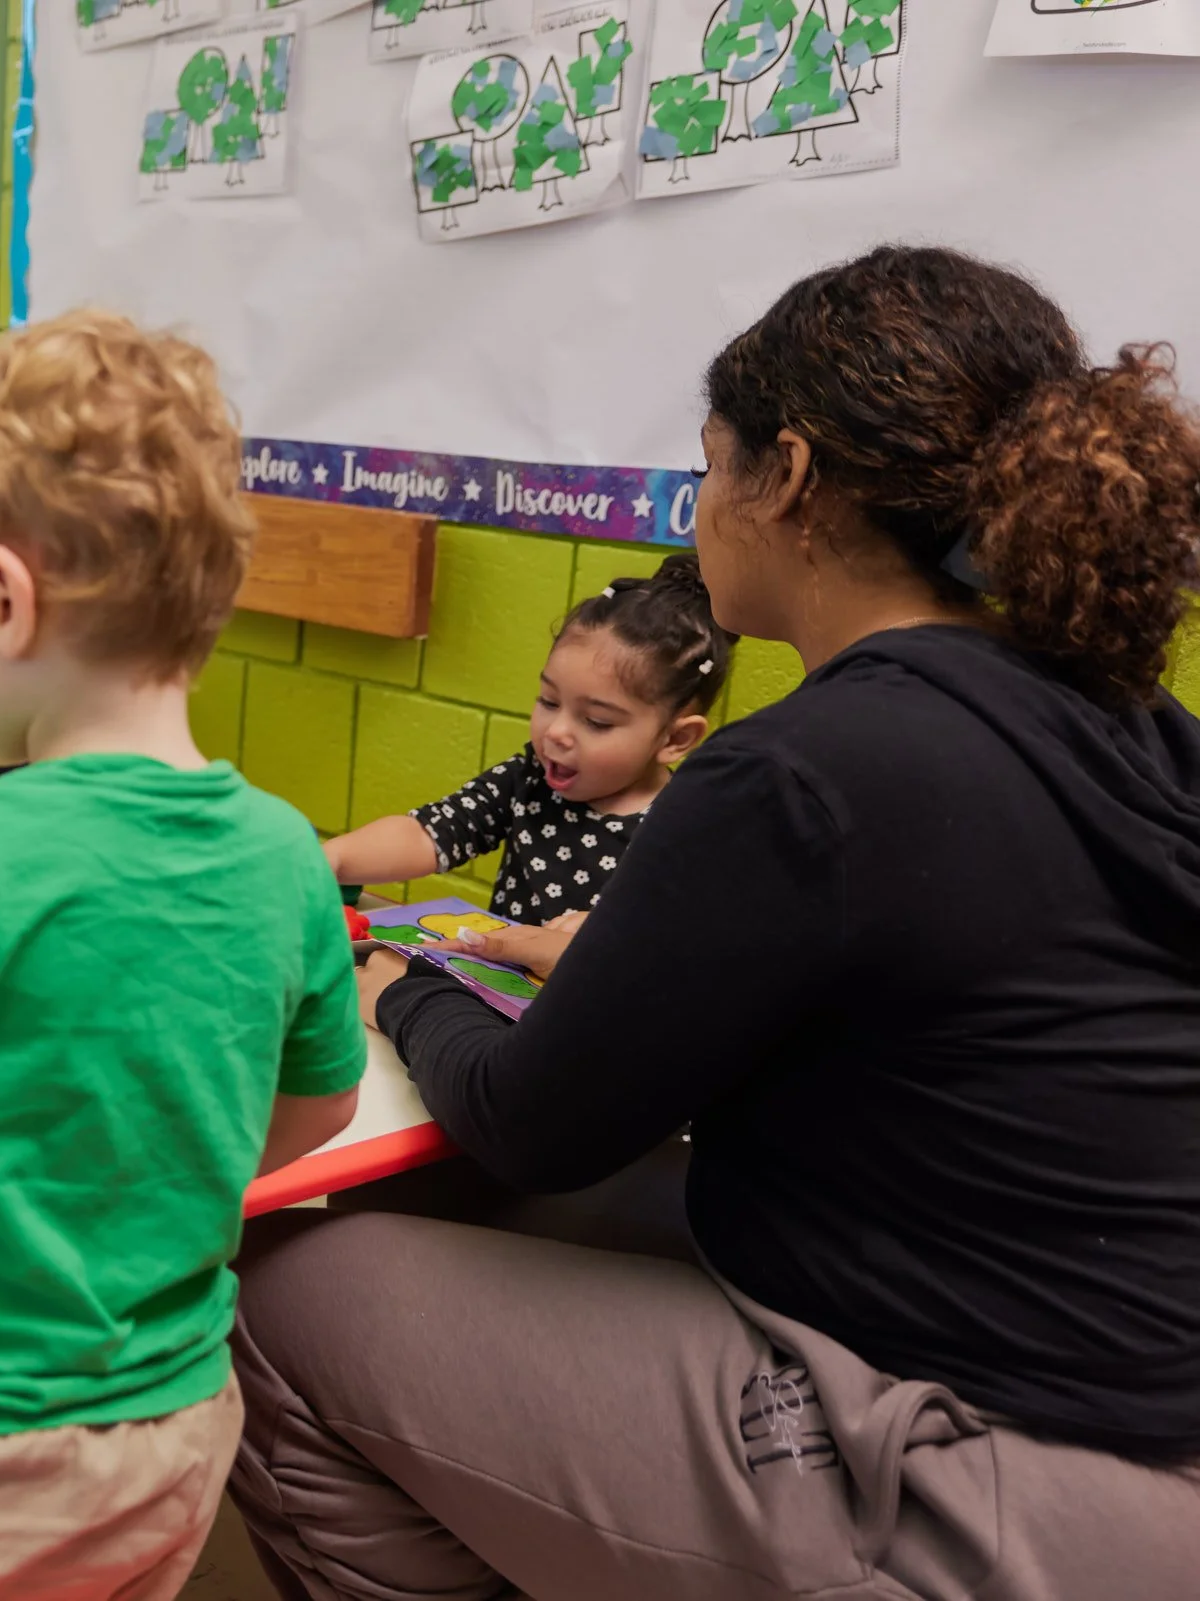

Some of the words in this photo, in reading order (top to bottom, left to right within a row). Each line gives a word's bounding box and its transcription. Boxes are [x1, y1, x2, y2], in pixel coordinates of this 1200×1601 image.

[340, 450, 449, 508] Imagine
[496, 469, 615, 521] Discover
[669, 483, 697, 536] C
